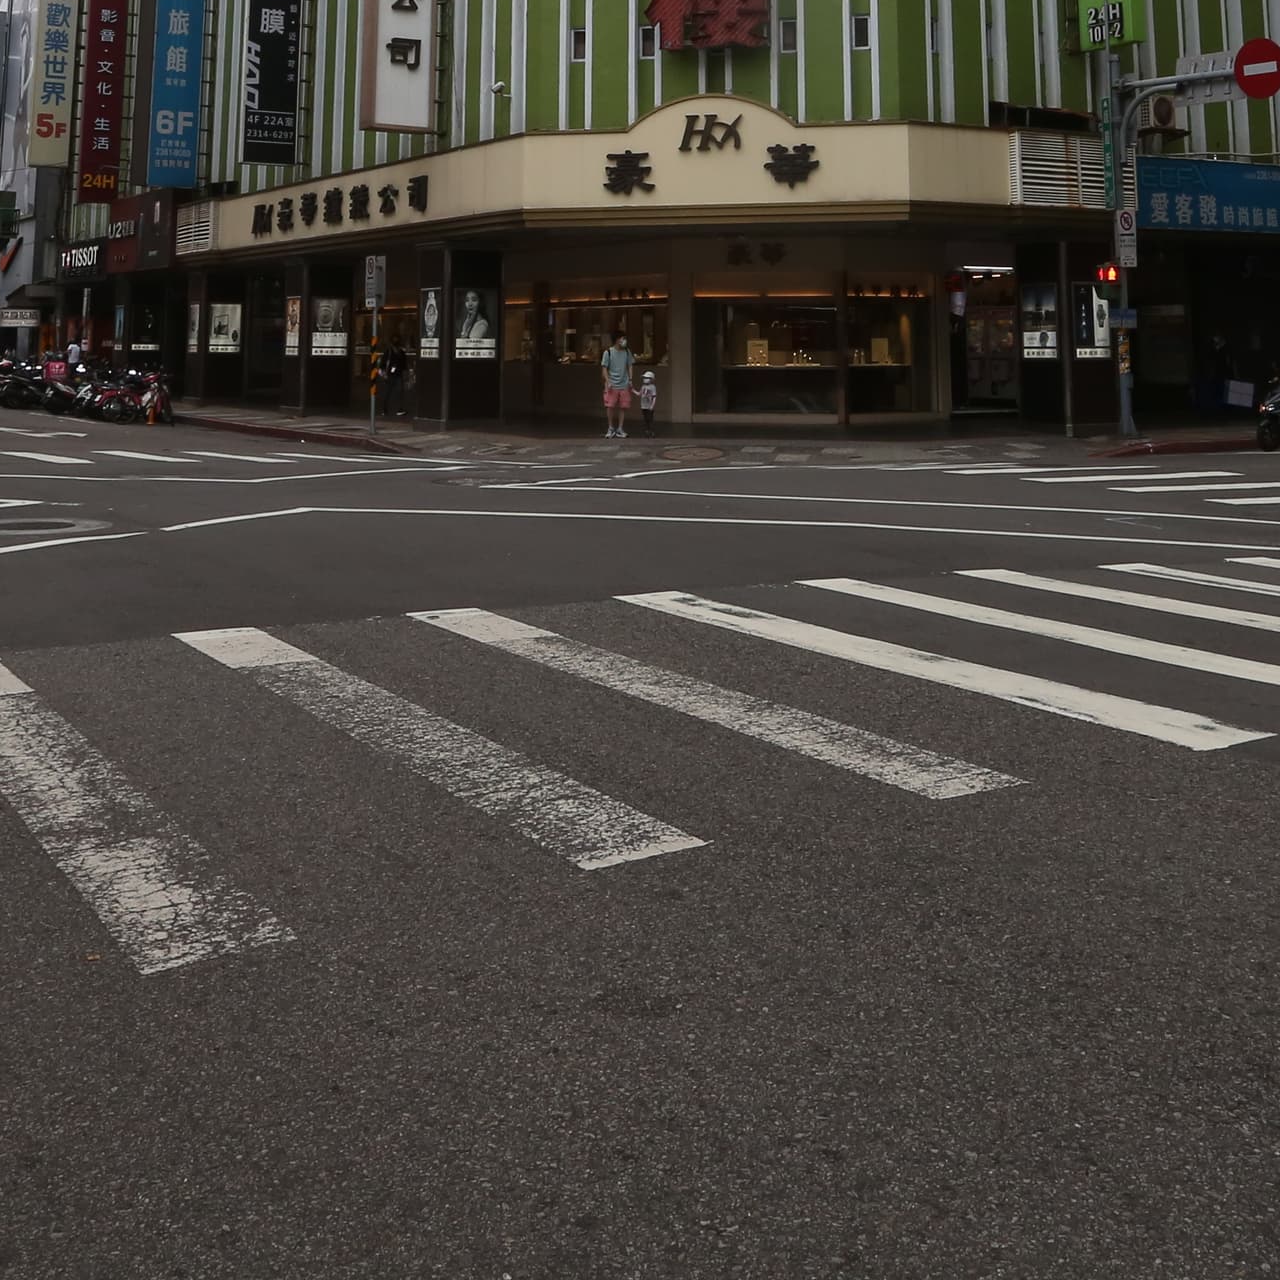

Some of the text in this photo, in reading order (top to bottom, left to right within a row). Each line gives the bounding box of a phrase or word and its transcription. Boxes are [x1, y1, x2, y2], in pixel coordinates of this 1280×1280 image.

[35, 112, 68, 139] 5F
[156, 110, 194, 136] 6F
[83, 173, 115, 190] 24H
[276, 174, 430, 233] 豪華鐘錶公司
[71, 245, 100, 268] TISSOT
